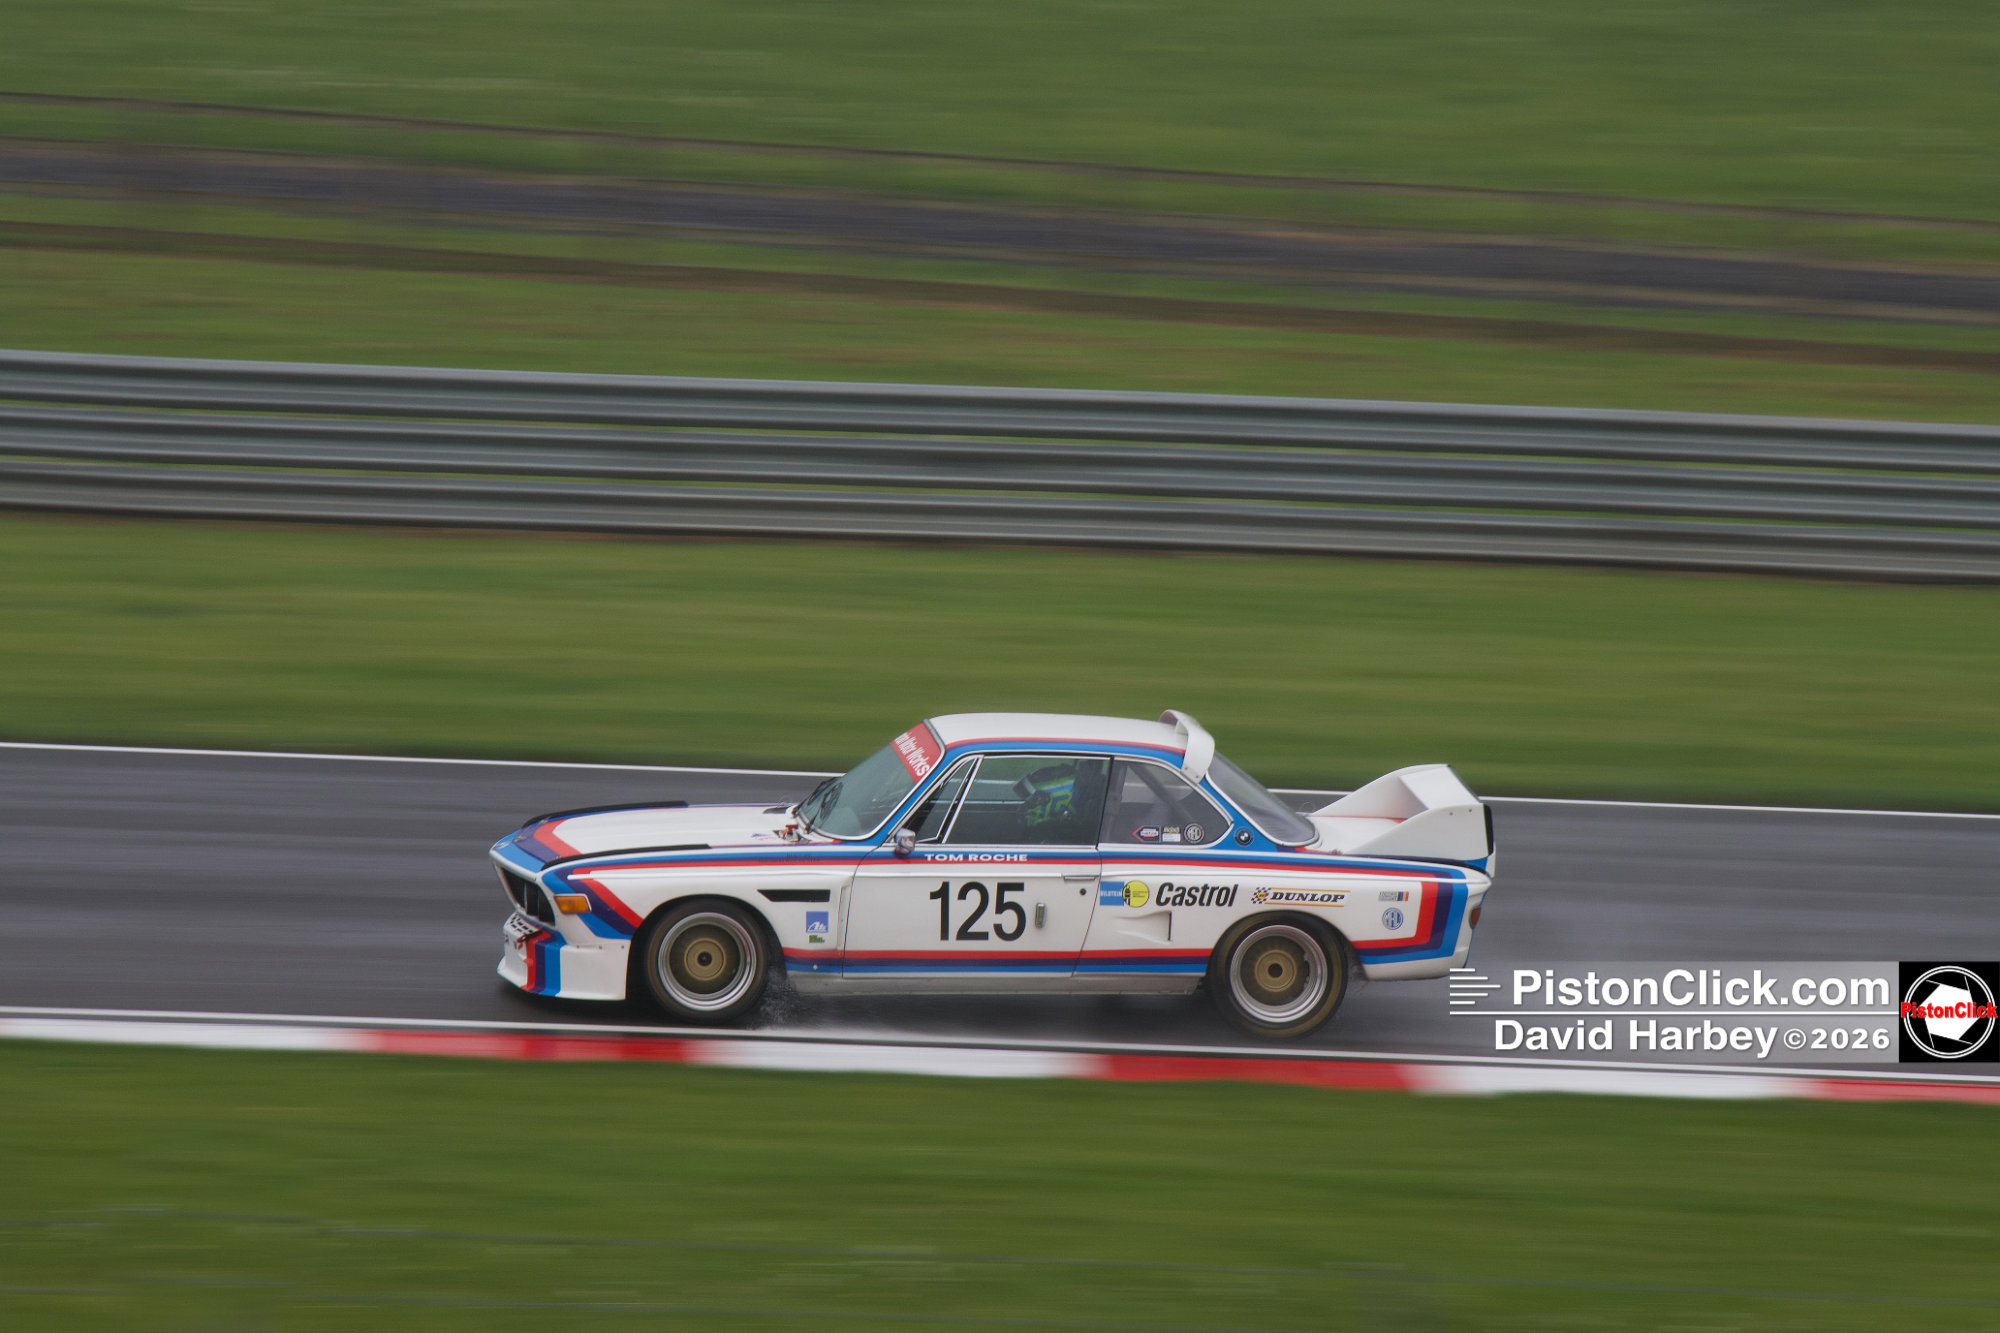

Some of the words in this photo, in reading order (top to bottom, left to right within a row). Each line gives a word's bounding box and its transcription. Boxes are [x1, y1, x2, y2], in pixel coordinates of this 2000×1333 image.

[1155, 882, 1239, 907] Castrol
[1270, 891, 1345, 903] DUNLOP
[929, 881, 1026, 941] 125
